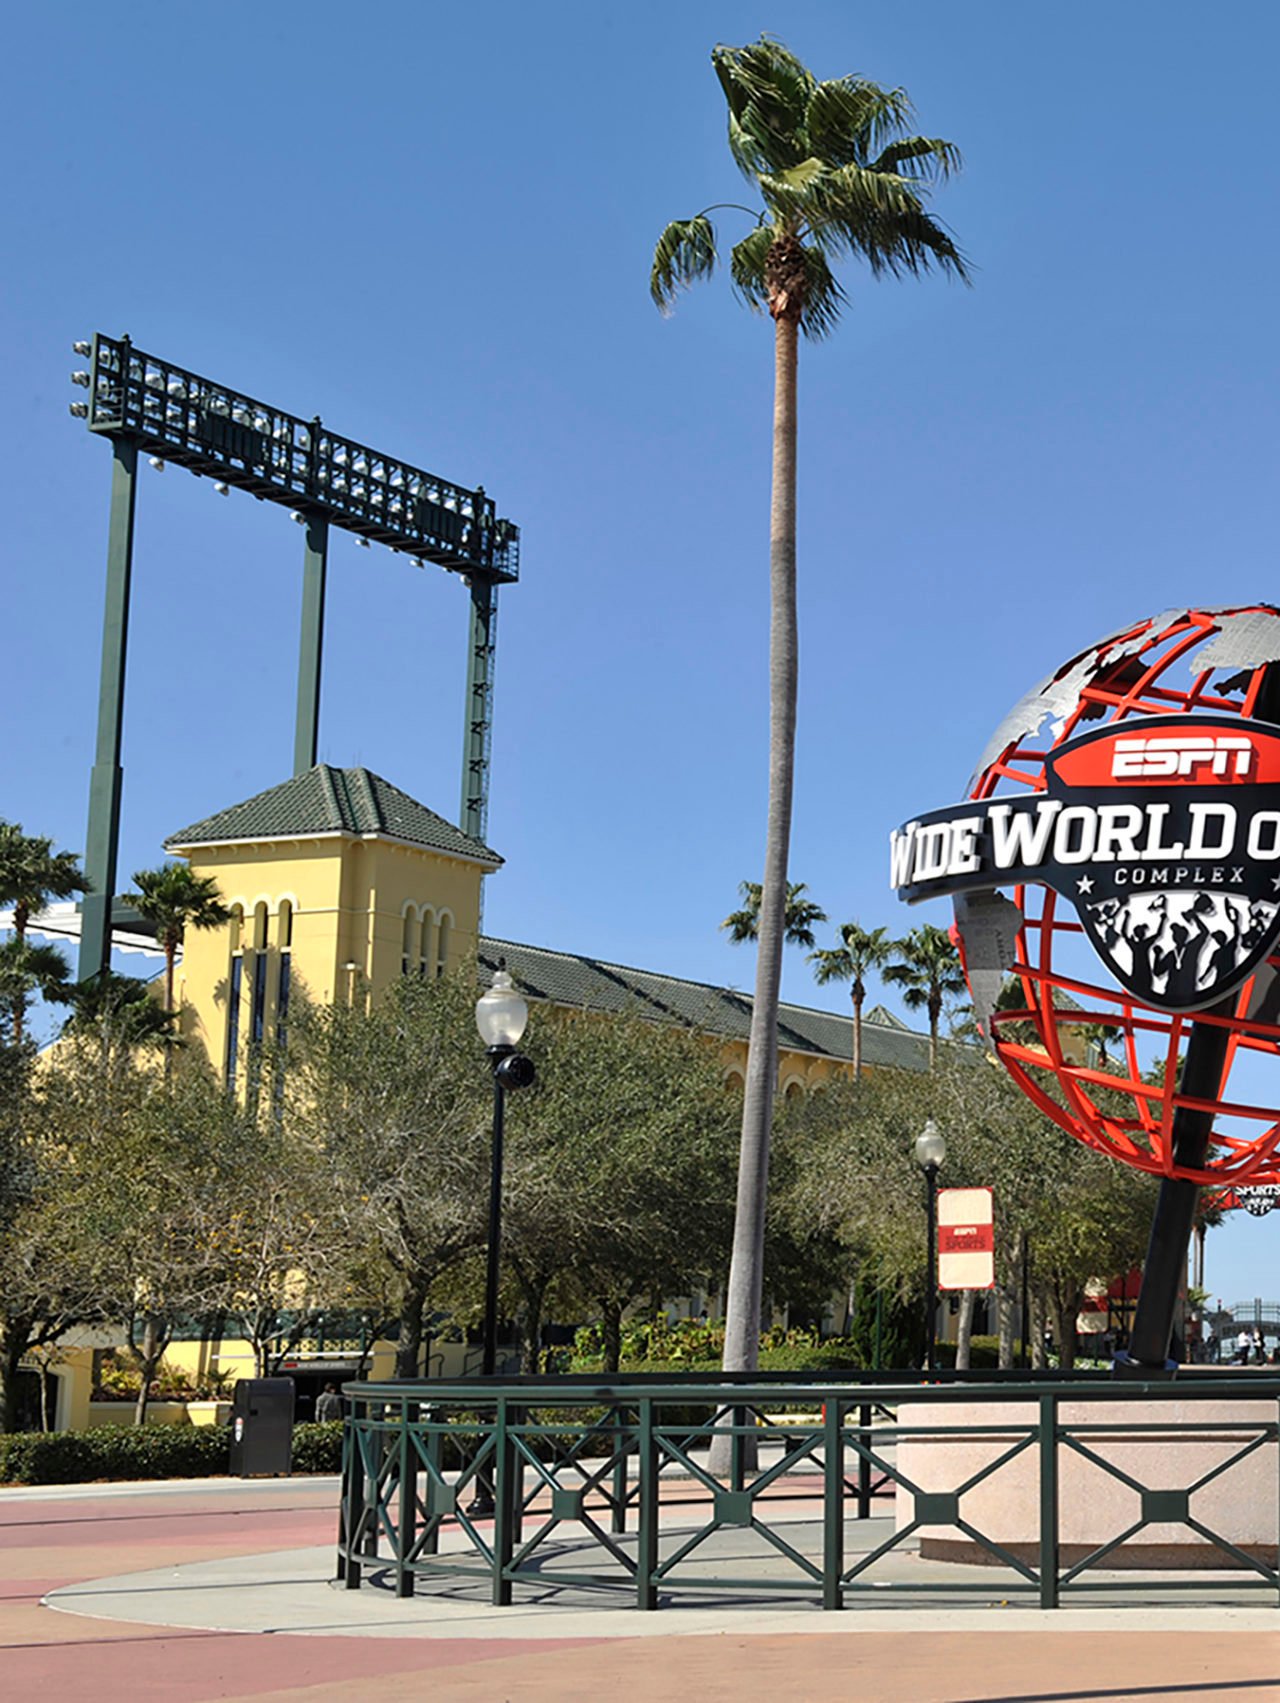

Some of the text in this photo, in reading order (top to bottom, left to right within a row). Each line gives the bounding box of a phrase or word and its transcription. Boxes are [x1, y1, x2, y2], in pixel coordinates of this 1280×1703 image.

[1111, 737, 1252, 777] ESPN
[889, 816, 983, 890] WIDE
[988, 800, 1237, 868] WORLD
[1114, 867, 1245, 885] COMPLEX
